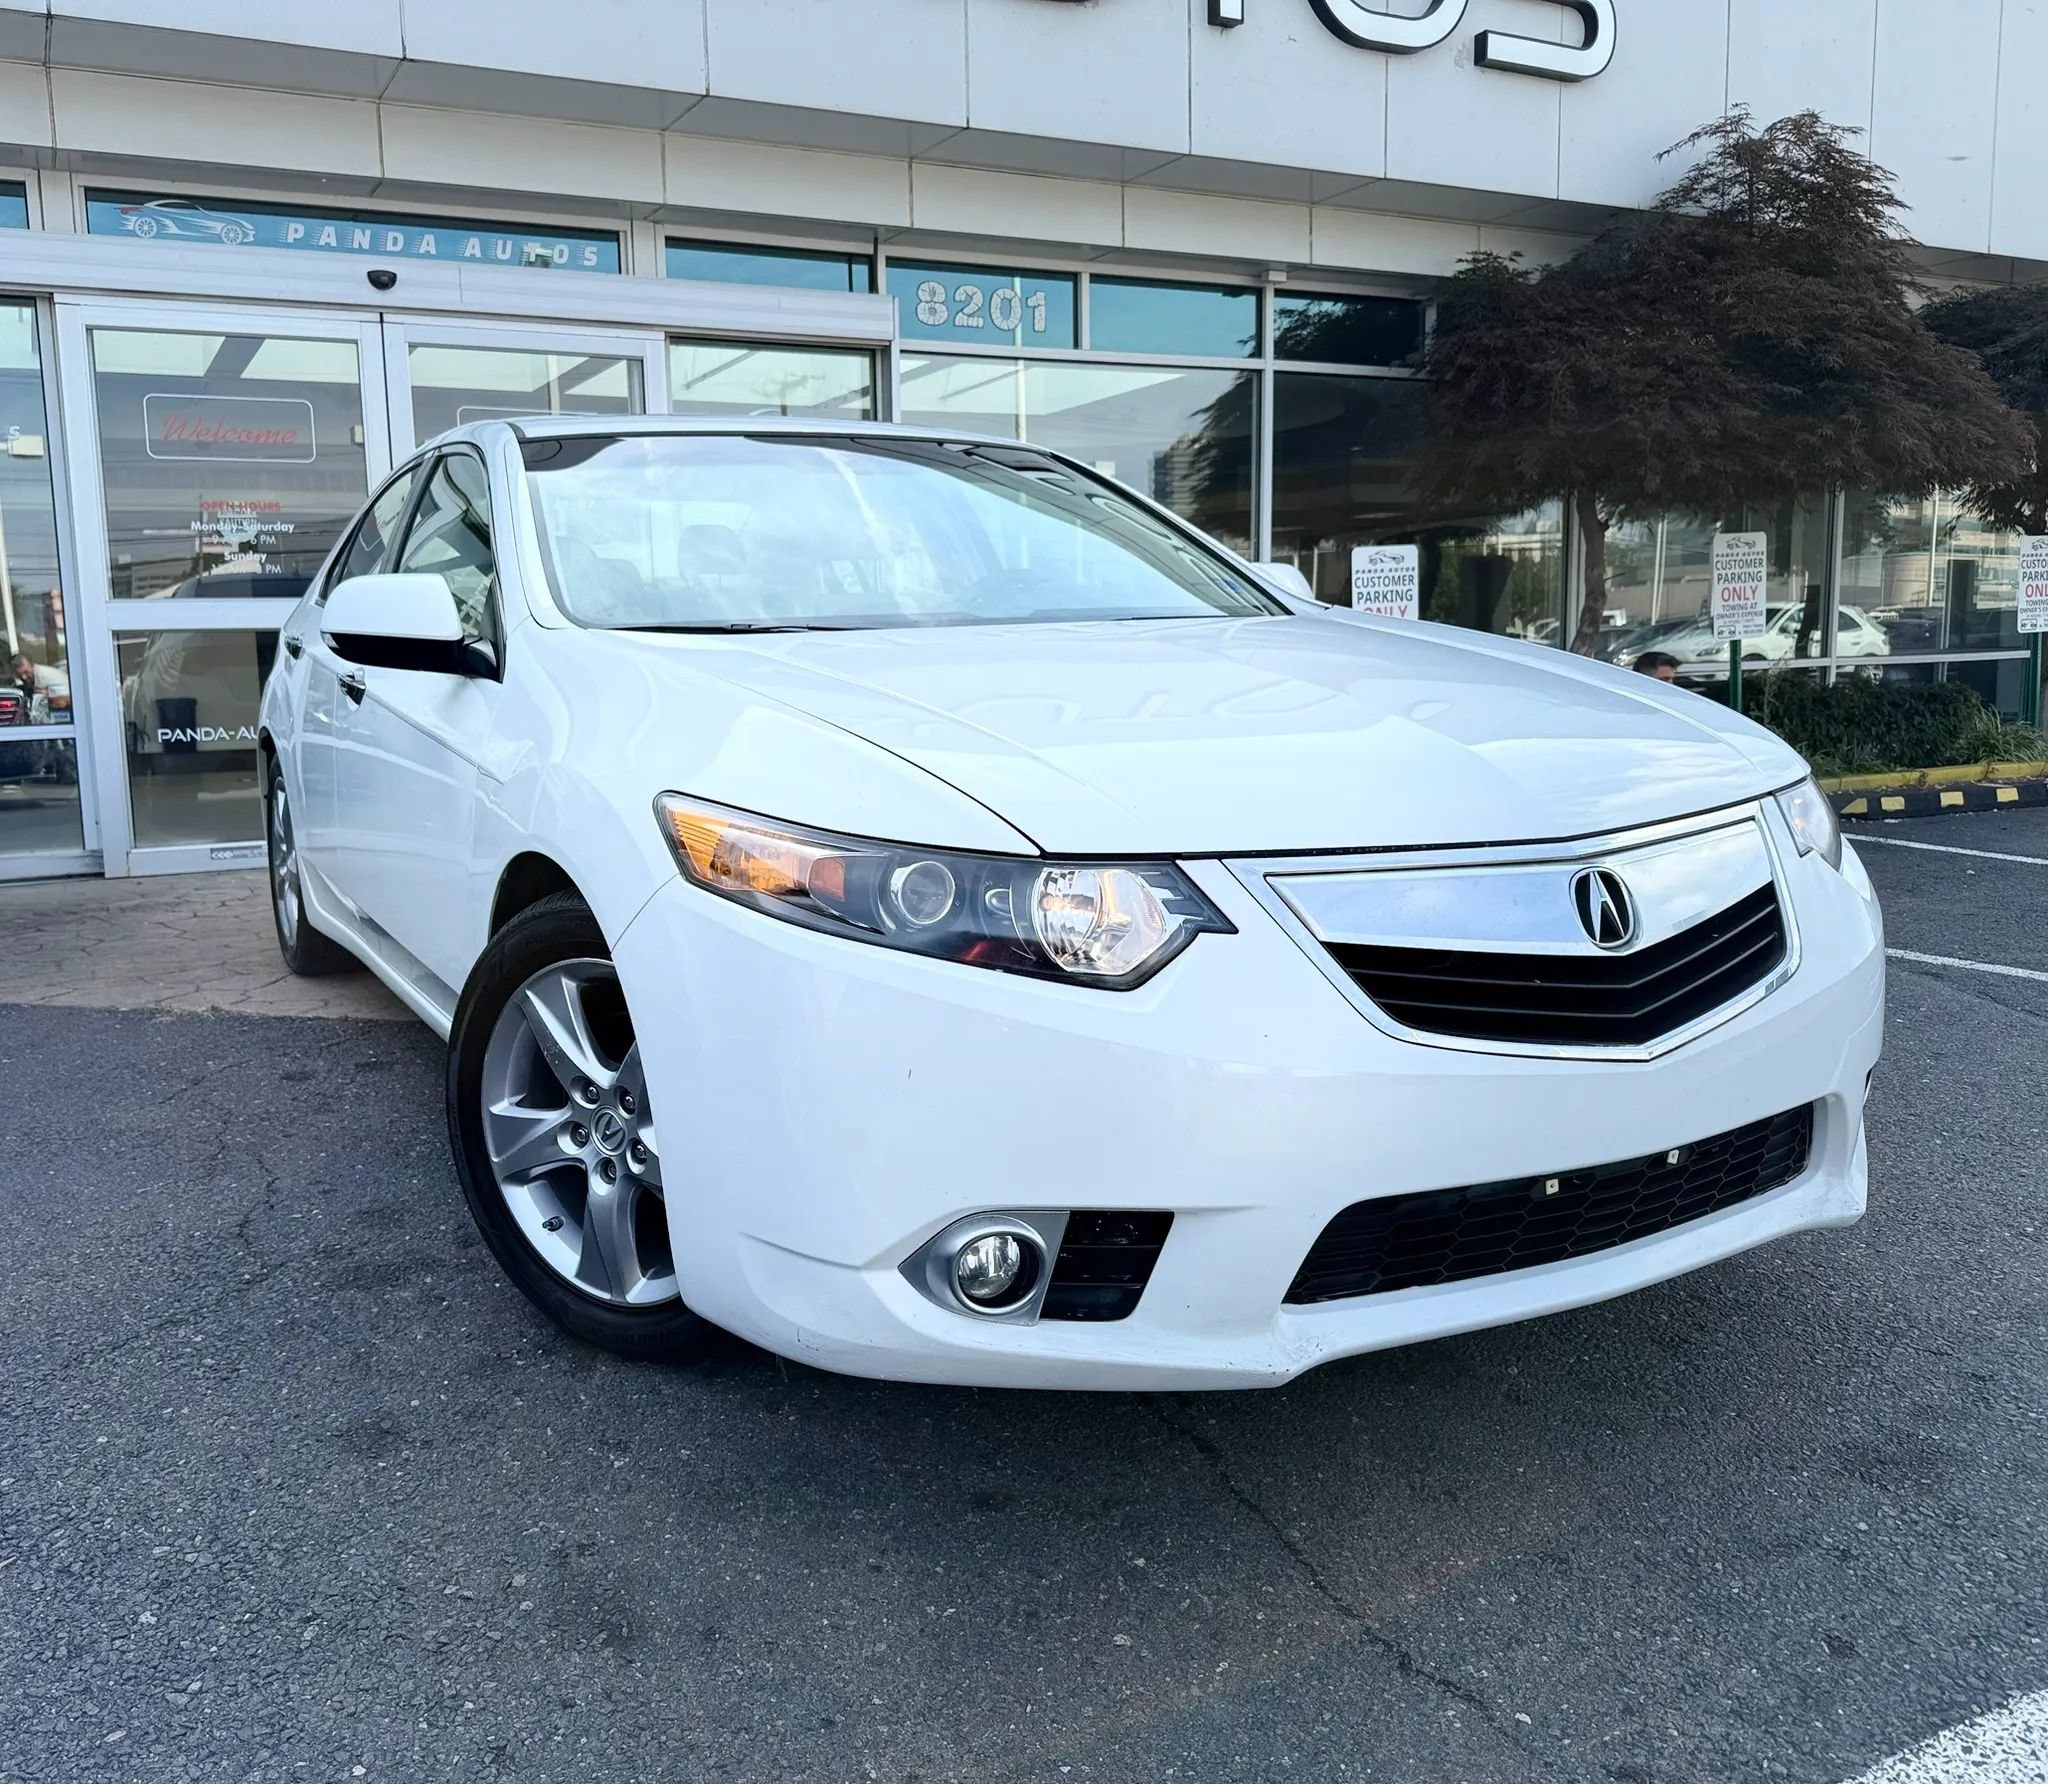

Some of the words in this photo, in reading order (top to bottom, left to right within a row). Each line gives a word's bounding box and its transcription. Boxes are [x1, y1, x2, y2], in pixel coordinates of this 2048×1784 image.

[286, 222, 437, 255] PANDA
[463, 237, 598, 266] AUTOS
[916, 280, 1047, 333] 8201
[161, 415, 297, 445] Welcome
[201, 501, 235, 512] OPEN
[191, 521, 295, 533] Monday-Saturday
[260, 534, 277, 544] PM
[224, 550, 267, 563] Sunday
[265, 563, 282, 574] PM
[1715, 558, 1764, 571] CUSTOMER
[1354, 574, 1415, 589] CUSTOMER
[1717, 571, 1762, 584] PARKING
[1357, 588, 1413, 604] PARKING
[1721, 585, 1758, 602] ONLY
[1722, 603, 1748, 612] TOWING
[1750, 602, 1758, 610] AT
